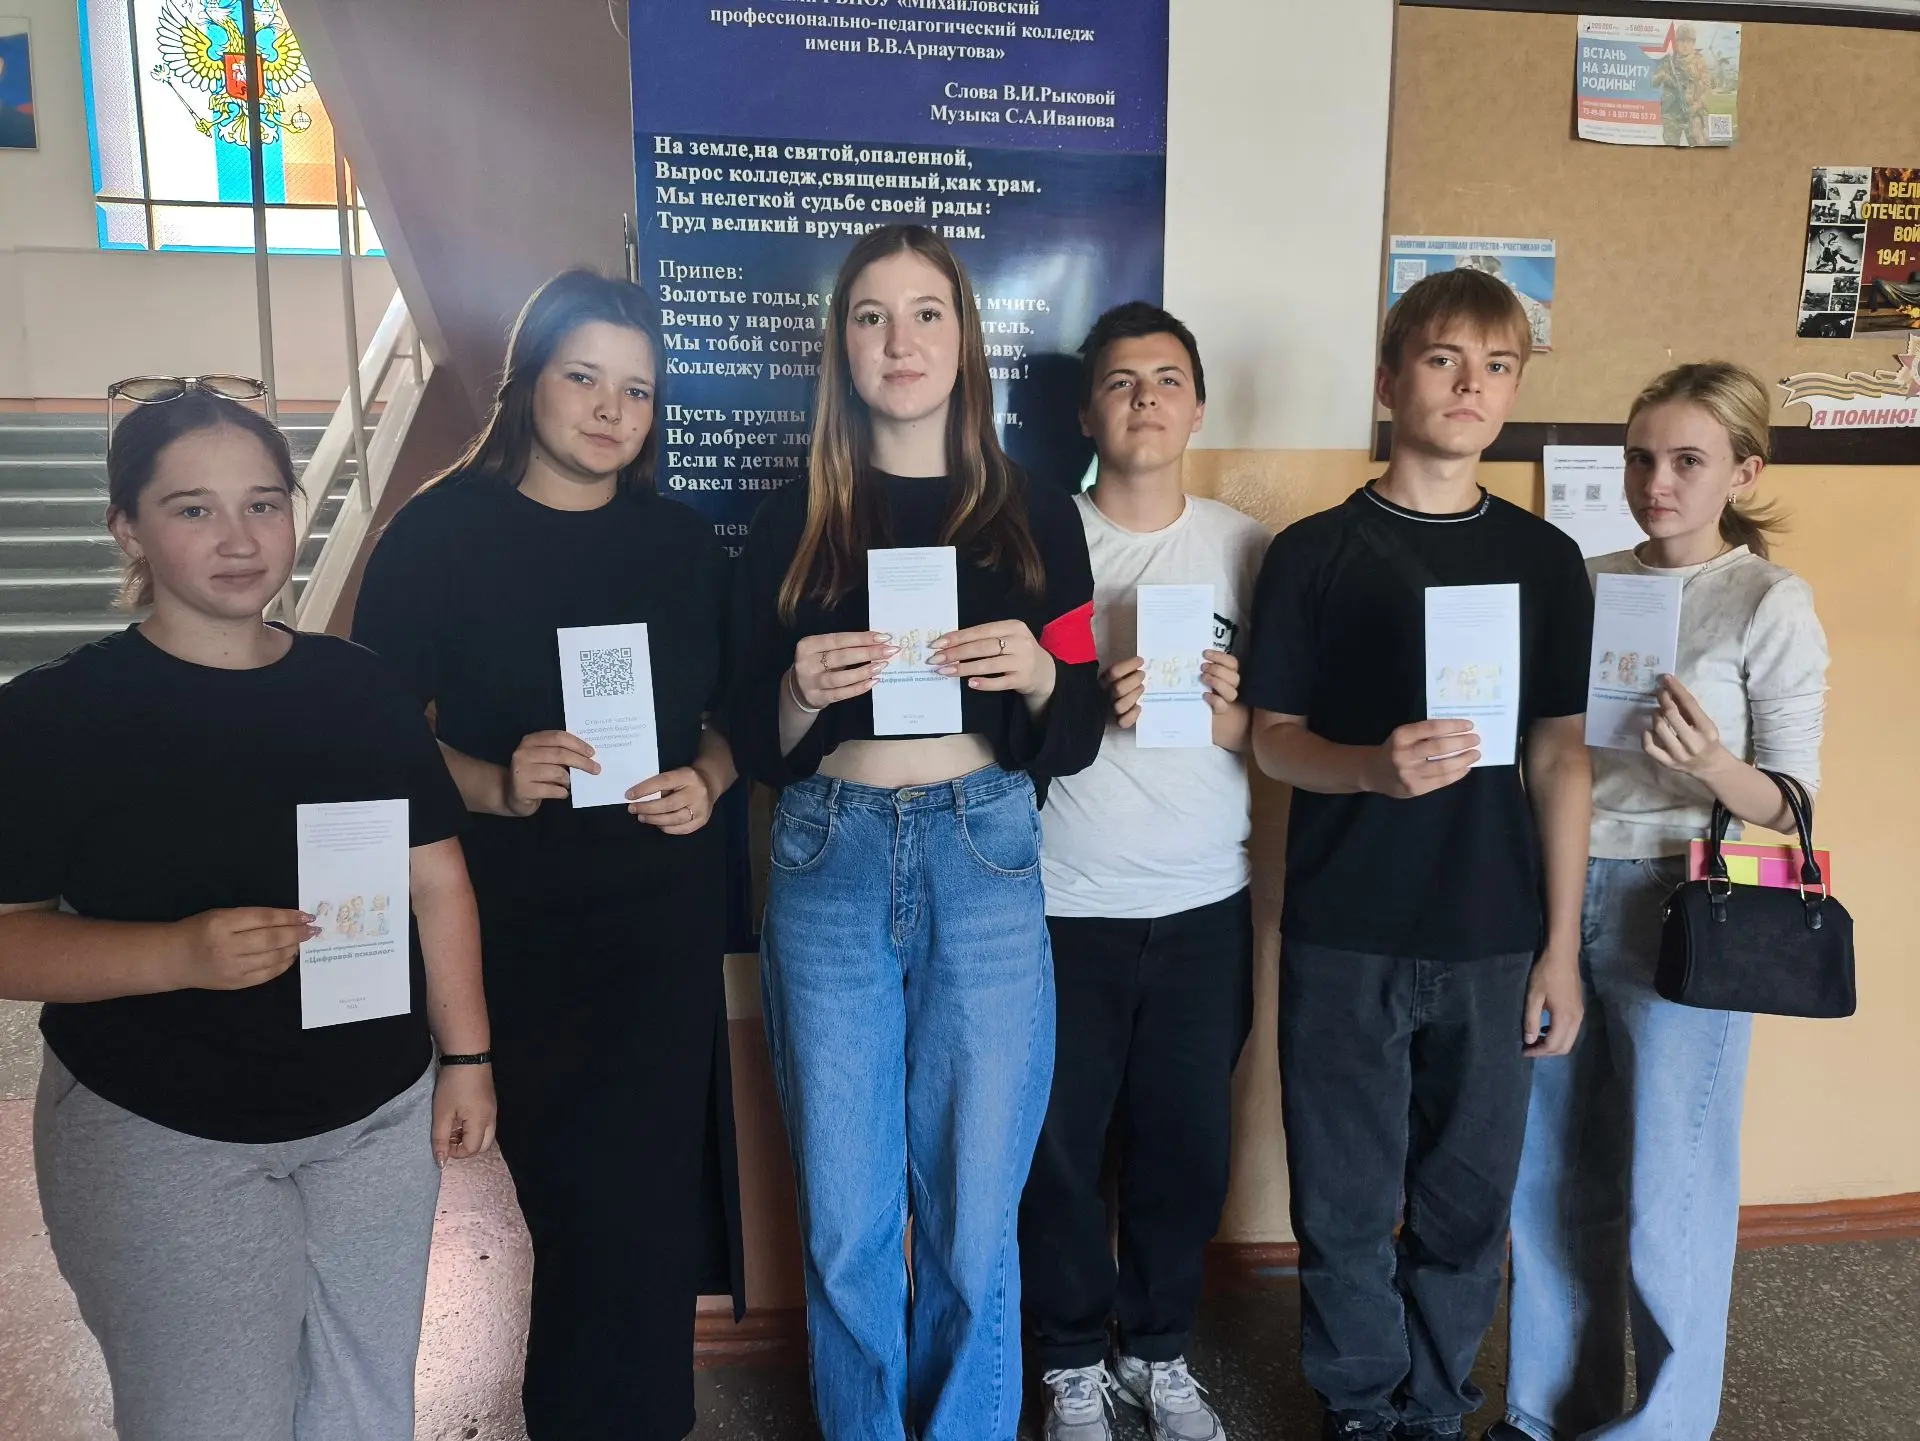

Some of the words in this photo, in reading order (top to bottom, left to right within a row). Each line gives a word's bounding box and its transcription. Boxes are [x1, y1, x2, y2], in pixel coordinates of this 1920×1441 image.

[711, 7, 1016, 38] профессионально-педагогический
[1022, 28, 1095, 42] колледж
[805, 37, 861, 52] имени
[867, 37, 1005, 60] В.В.Арнаутова»
[1583, 46, 1627, 61] ВСТАНЬ
[1582, 61, 1599, 74] НА
[1602, 63, 1650, 78] ЗАЩИТУ
[944, 82, 998, 100] Слова
[1003, 84, 1116, 106] В.И.Рыковой
[1582, 75, 1636, 92] РОДИНЫ!
[930, 105, 1000, 125] Музыка
[1005, 108, 1115, 128] С.А.Иванова
[654, 136, 683, 154] На
[655, 161, 723, 184] Вырос
[987, 178, 1042, 196] храм.
[656, 186, 695, 205] Мы
[701, 192, 795, 209] нелегкой
[802, 194, 865, 214] судьбе
[871, 197, 926, 214] своей
[932, 201, 992, 218] рады:
[1861, 203, 1920, 220] ОТЕЧЕСТ
[657, 211, 706, 234] Труд
[712, 216, 799, 234] великий
[806, 219, 886, 239] вручае
[943, 225, 986, 240] нам.
[1893, 223, 1920, 243] ВОЙ
[1877, 249, 1907, 266] 1941
[659, 260, 744, 282] Припев:
[660, 285, 747, 304] Золотые
[987, 297, 1050, 314] мчите,
[661, 309, 723, 327] Вечно
[729, 315, 740, 331] у
[746, 315, 815, 333] народа
[664, 333, 700, 351] Мы
[706, 334, 763, 352] тобой
[769, 338, 824, 357] согре
[984, 343, 1027, 361] раву.
[666, 357, 763, 379] Колледжу
[989, 364, 1029, 380] ава!
[665, 404, 726, 425] Пусть
[732, 409, 805, 426] трудны
[1813, 410, 1828, 426] Я
[1831, 408, 1918, 425] ПОМНЮ!
[666, 428, 695, 445] Но
[700, 429, 777, 449] добреет
[783, 432, 811, 446] лю
[668, 451, 717, 468] Если
[723, 456, 736, 468] к
[741, 455, 799, 470] детям
[668, 474, 733, 491] Факел
